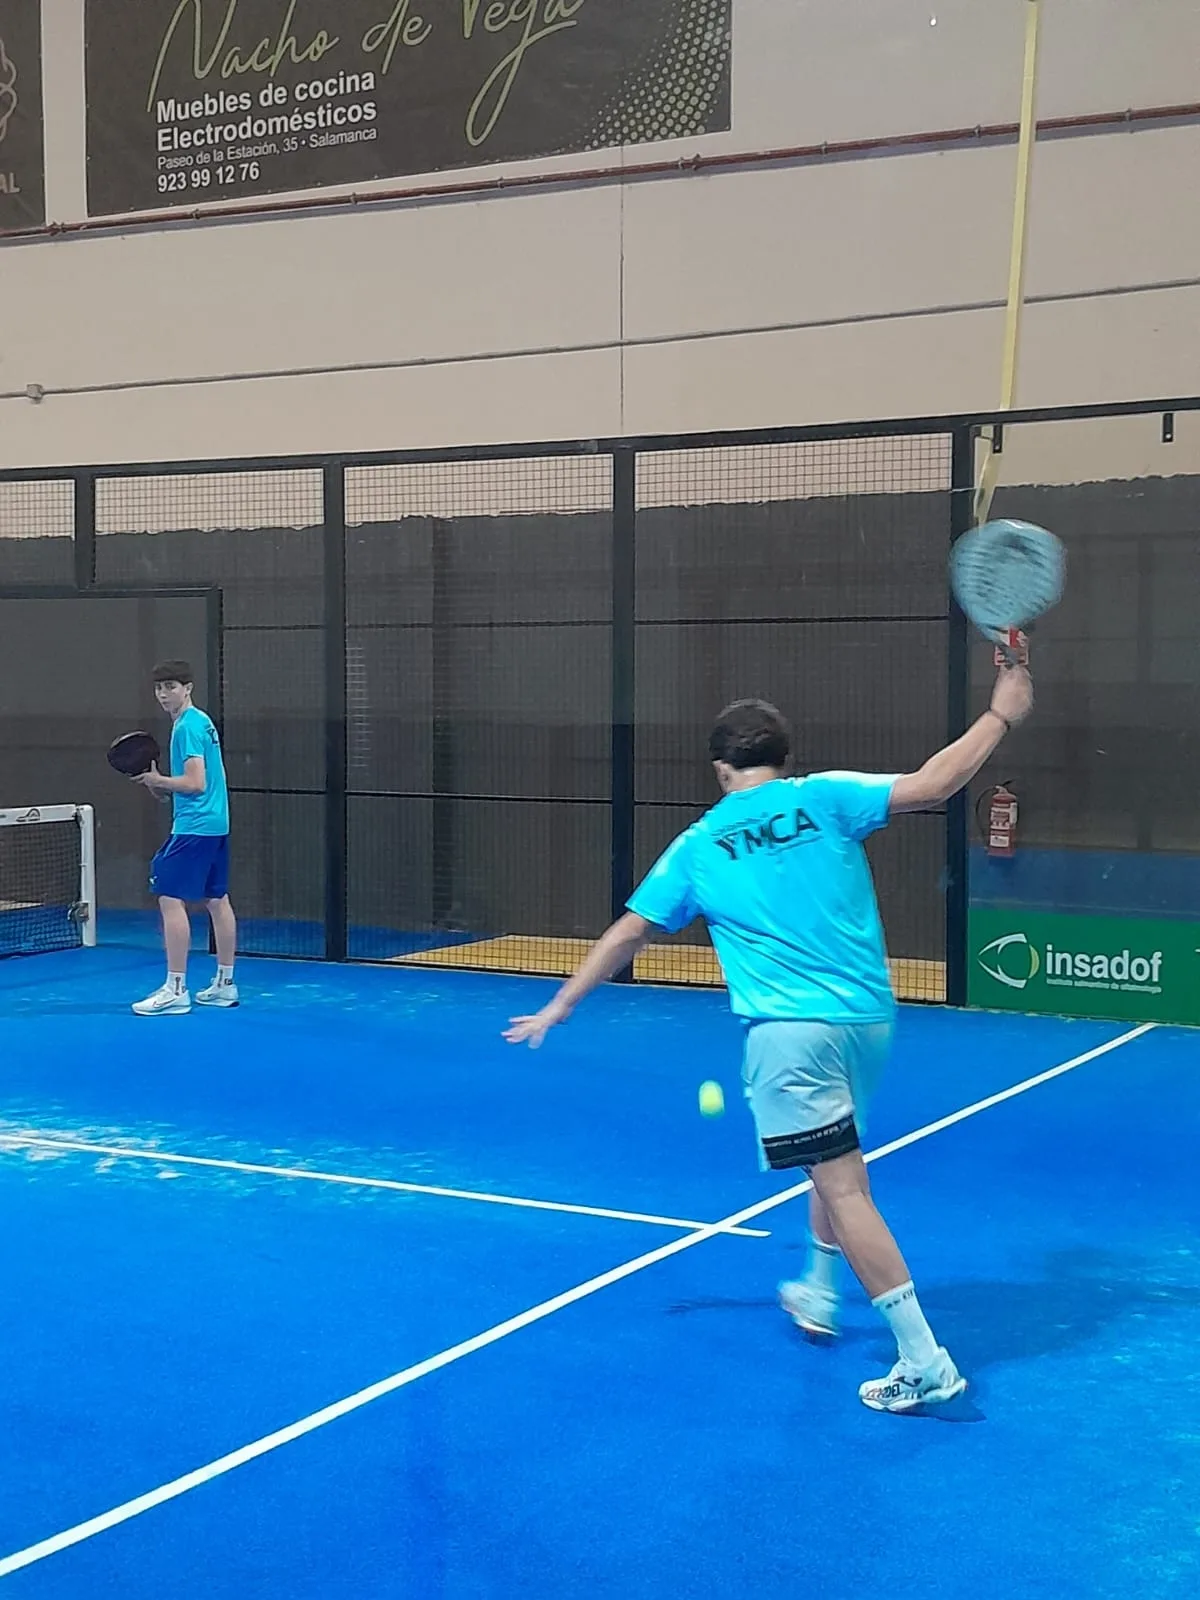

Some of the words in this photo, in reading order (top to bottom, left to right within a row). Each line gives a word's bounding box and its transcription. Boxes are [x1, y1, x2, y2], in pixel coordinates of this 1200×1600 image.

[147, 0, 339, 112] Nacho
[362, 0, 432, 75] de
[157, 90, 252, 123] Muebles
[259, 82, 288, 107] de
[294, 70, 375, 101] cocina
[157, 101, 377, 152] Electrodomésticos
[158, 156, 194, 170] Paseo
[195, 151, 211, 165] de
[213, 149, 224, 162] la
[226, 141, 280, 160] Estación,
[283, 136, 298, 152] 35
[309, 128, 377, 148] Salamanca
[158, 171, 187, 193] 923
[191, 168, 211, 188] 99
[215, 164, 235, 185] 12
[239, 161, 260, 181] 76
[713, 807, 822, 860] YMCA
[1046, 944, 1162, 983] insadof
